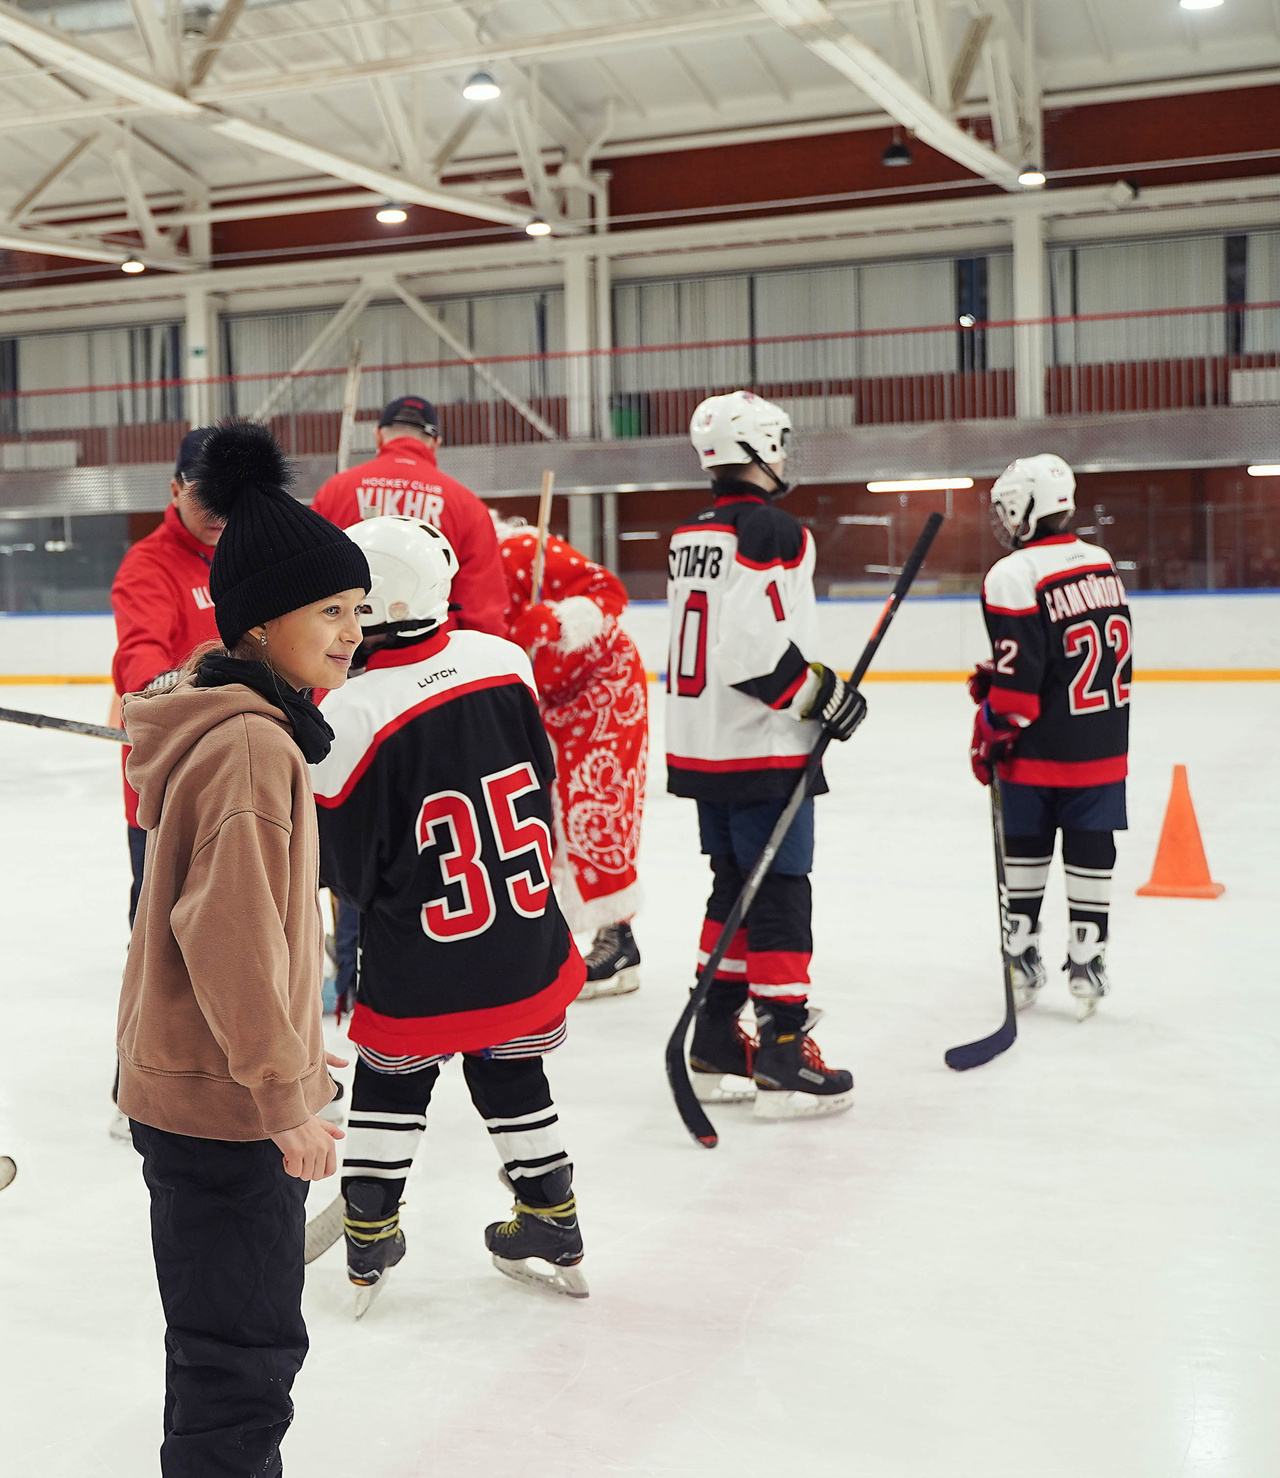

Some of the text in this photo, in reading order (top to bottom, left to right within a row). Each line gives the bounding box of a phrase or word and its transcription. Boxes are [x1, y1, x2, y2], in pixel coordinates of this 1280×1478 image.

[362, 477, 442, 495] HOCKEY CLUB
[996, 638, 1019, 675] 2
[1063, 614, 1132, 716] 22
[417, 667, 458, 688] LUTCH
[416, 762, 557, 943] 35
